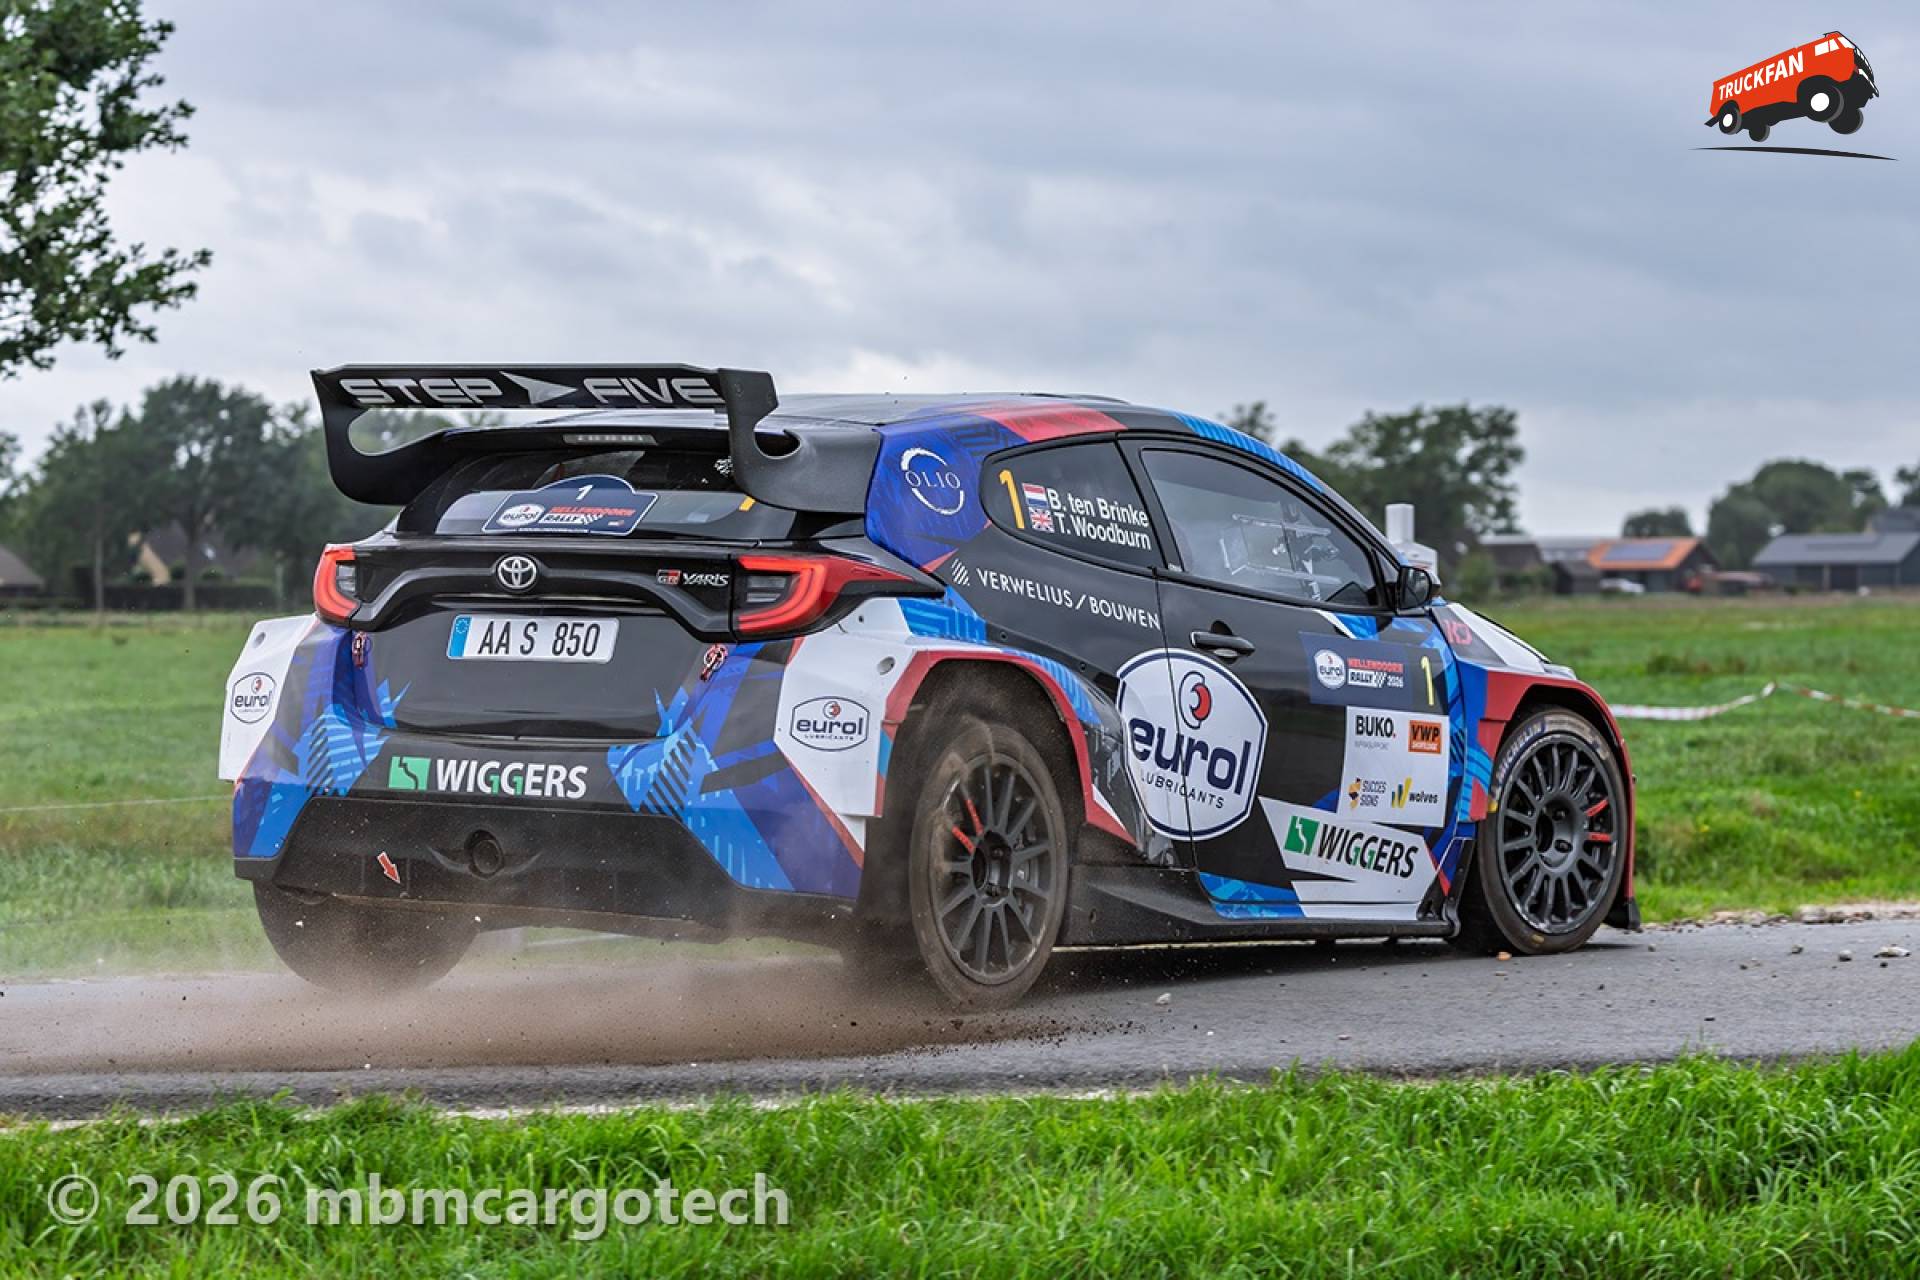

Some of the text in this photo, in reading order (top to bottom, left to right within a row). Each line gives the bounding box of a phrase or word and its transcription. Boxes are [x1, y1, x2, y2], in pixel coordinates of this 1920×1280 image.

[338, 378, 726, 404] STEP FIVE
[575, 484, 594, 501] 1
[905, 471, 961, 490] OLIO
[999, 469, 1025, 530] 1
[1046, 488, 1151, 528] B. ten Brinke
[1052, 511, 1152, 550] T. Woodburn
[682, 573, 730, 587] YARIS
[477, 620, 602, 657] AA S 850
[1350, 672, 1374, 685] RALLY
[1420, 655, 1435, 707] 1
[234, 690, 273, 708] eurol
[796, 716, 864, 736] eurol
[1410, 723, 1440, 743] VWP
[1128, 717, 1252, 796] eurol
[436, 758, 590, 800] WIGGERS
[1408, 791, 1439, 804] wolves
[1317, 823, 1419, 879] WIGGERS
